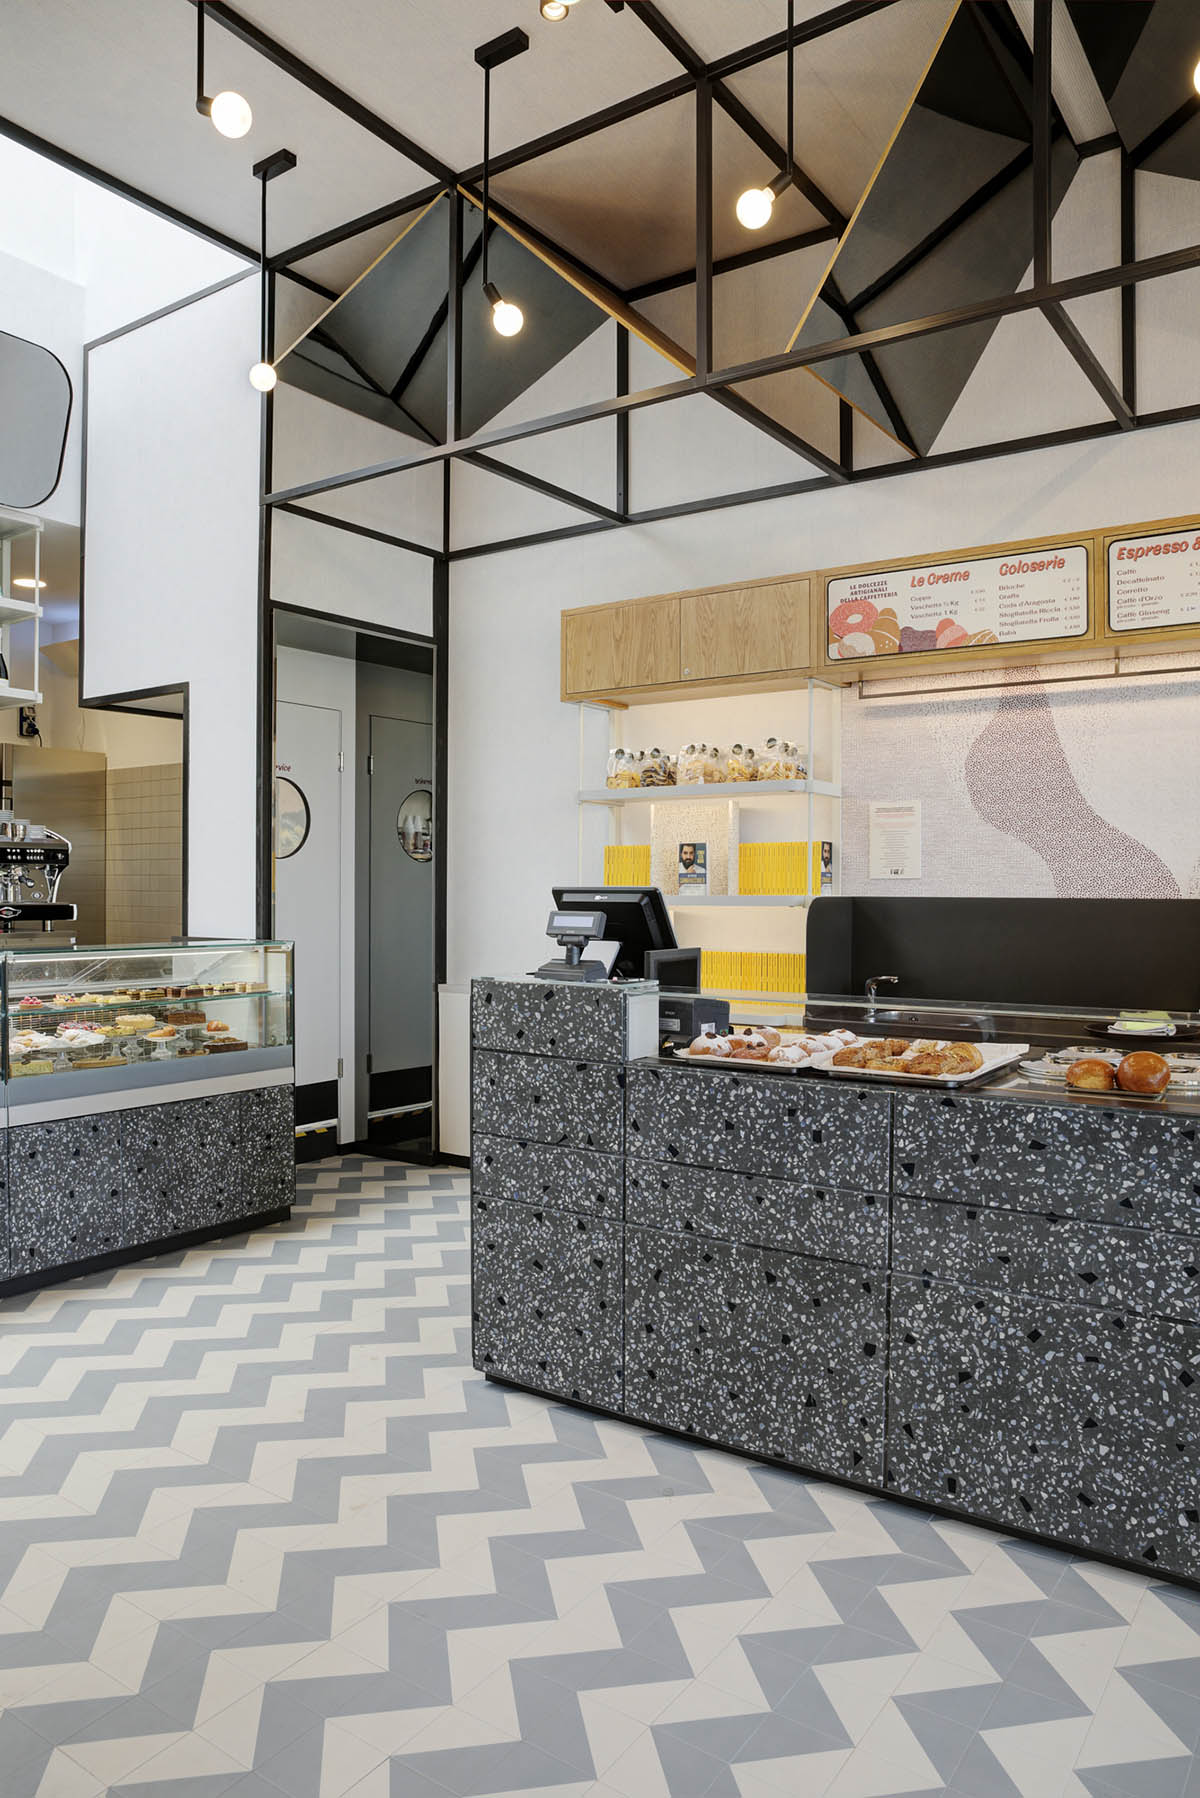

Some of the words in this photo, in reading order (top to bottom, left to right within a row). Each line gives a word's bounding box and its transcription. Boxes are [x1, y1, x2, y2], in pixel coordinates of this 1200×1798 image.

[1116, 541, 1189, 562] Espresso
[911, 575, 925, 588] Le
[927, 570, 970, 585] Creme
[858, 580, 888, 589] DOLCEZZE
[850, 587, 888, 596] ARTIGIANALI
[860, 592, 898, 600] CAFFETTERIA
